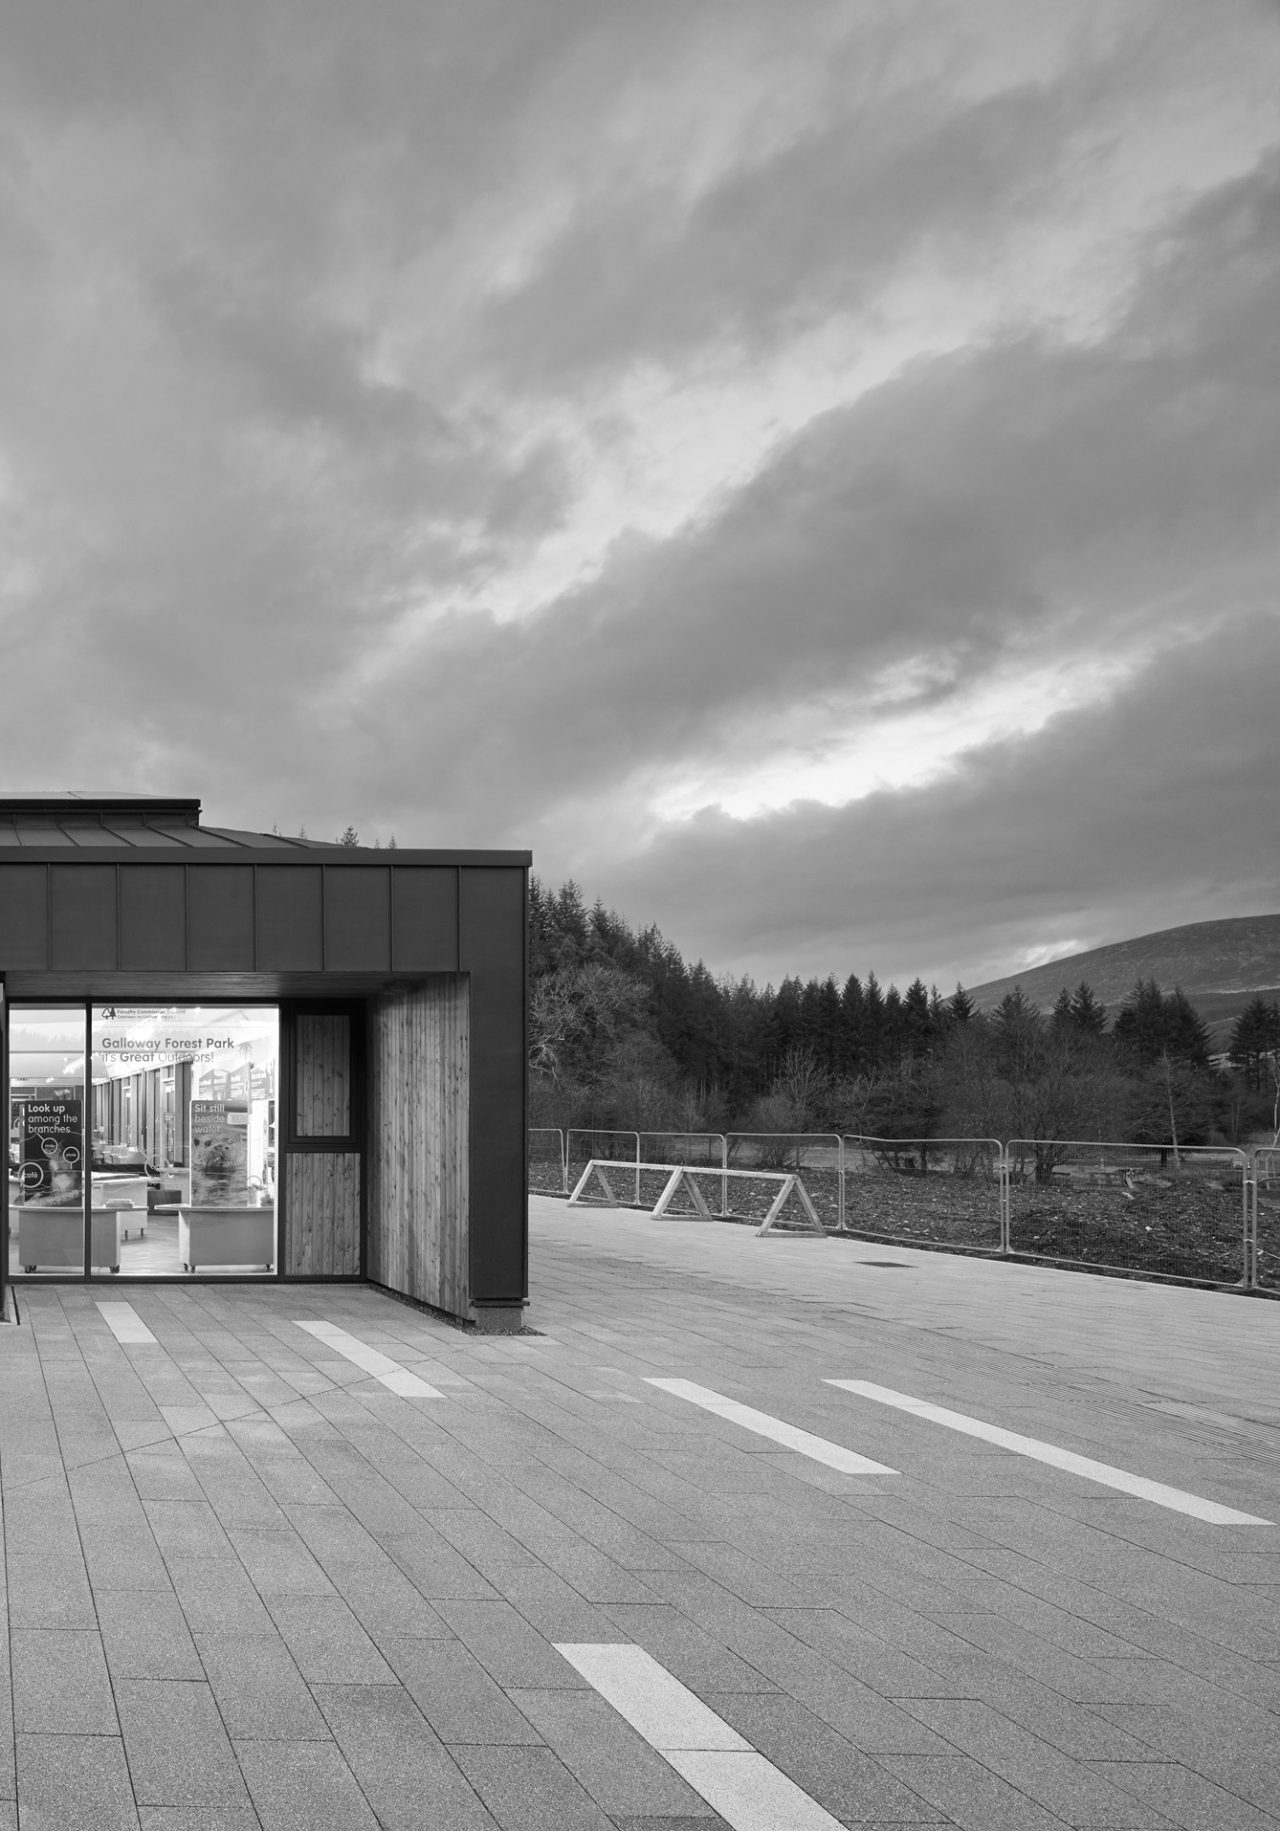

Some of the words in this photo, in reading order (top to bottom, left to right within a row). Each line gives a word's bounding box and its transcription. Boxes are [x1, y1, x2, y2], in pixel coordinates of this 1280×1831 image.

[102, 1037, 161, 1052] Galloway
[165, 1038, 202, 1049] Forest
[206, 1037, 235, 1049] Park
[120, 1052, 154, 1062] Great
[158, 1051, 214, 1062] Outdoors!
[28, 1104, 50, 1113] Look
[53, 1106, 65, 1114] up
[194, 1104, 207, 1113] Sit
[209, 1104, 225, 1113] still
[28, 1115, 61, 1125] among
[63, 1113, 78, 1123] the
[194, 1113, 225, 1123] beside
[28, 1124, 71, 1134] branches
